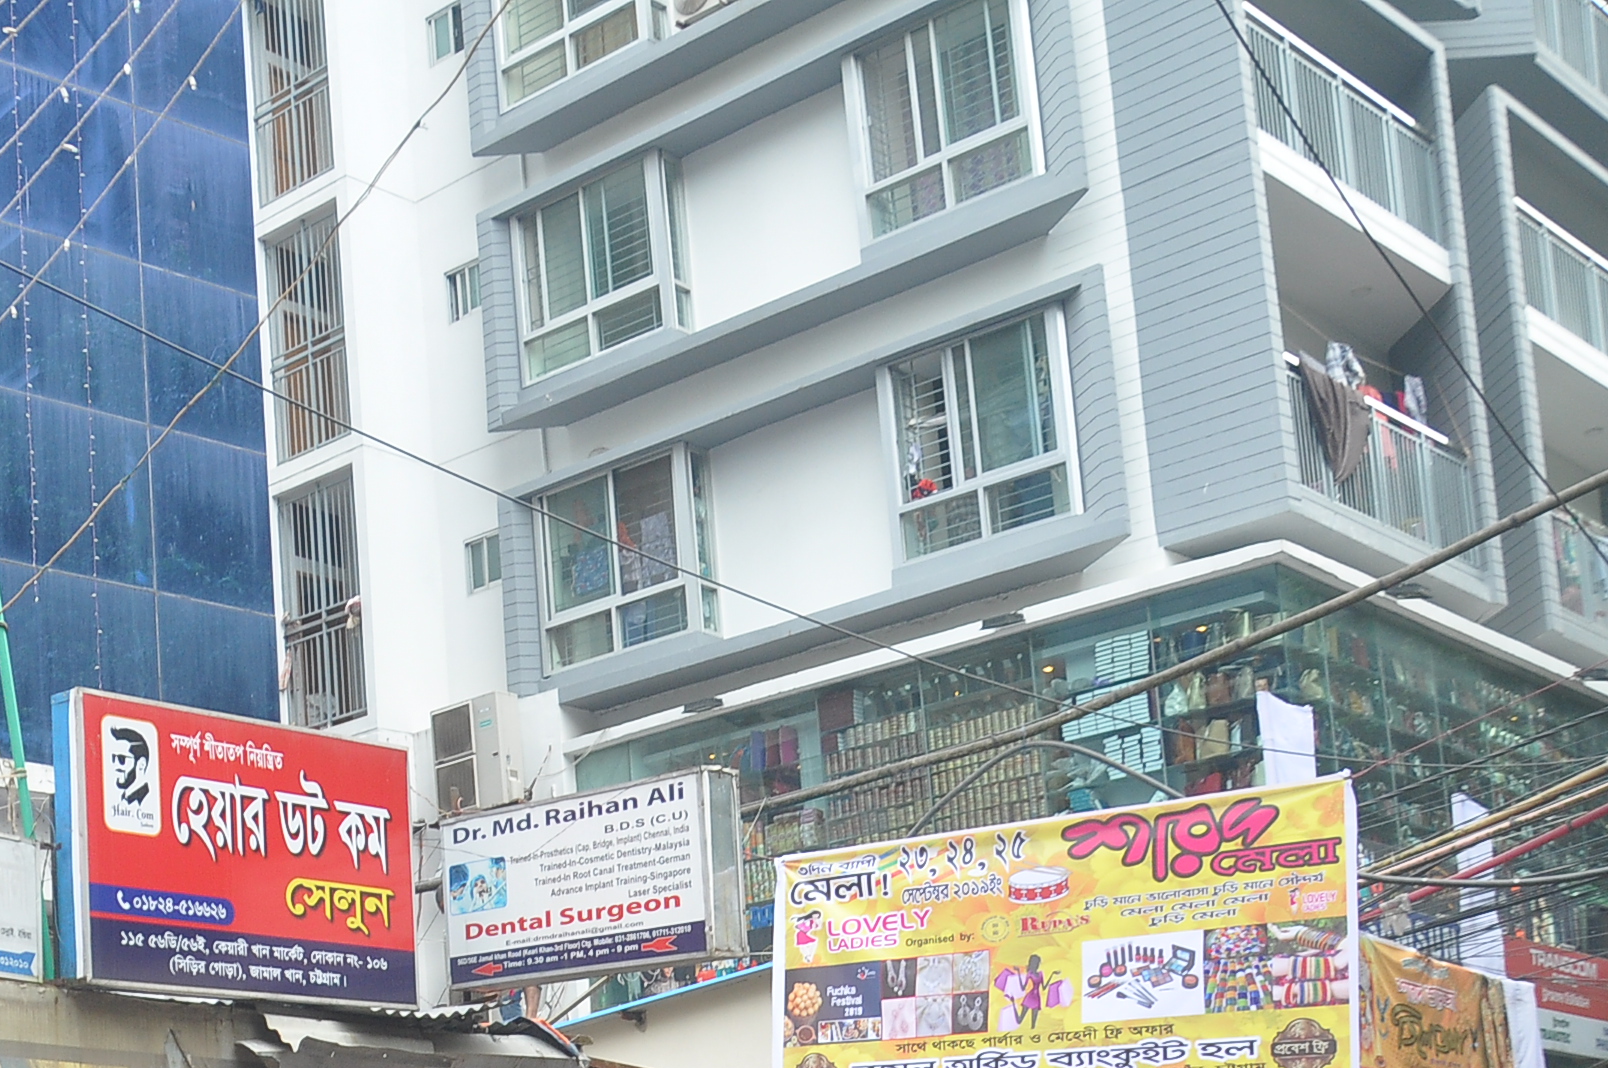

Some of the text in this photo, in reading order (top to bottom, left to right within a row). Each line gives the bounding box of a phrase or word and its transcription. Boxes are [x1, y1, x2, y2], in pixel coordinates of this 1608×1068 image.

[169, 730, 284, 771] সম্পূর্ণ শীতাতপ নিয়ন্ত্রিত
[171, 769, 391, 875] হেয়ার ডট কম
[452, 782, 686, 846] Dr. Md. Raihan Ali
[616, 838, 690, 859] Dentistry-Malaysia
[995, 830, 1029, 862] ২৫
[1209, 837, 1343, 877] মেলা
[592, 852, 691, 878] Canal Treatment-German
[550, 866, 691, 898] Advance Implant Training-Singapore
[628, 879, 692, 899] Laser Specialist
[901, 882, 950, 906] সেপ্টেম্বর
[1145, 885, 1209, 903] ভালোবাসা
[132, 895, 227, 921] ০১৮২৪-৫১৬৬২৬
[285, 877, 395, 937] সেলুন
[464, 893, 682, 941] Dental Surgeon
[1120, 893, 1269, 918] মেলা মেলা মেলা
[1192, 907, 1237, 922] মেলা
[826, 908, 933, 937] LOVELY
[120, 930, 344, 967] ১১৫ কেয়ারী দোকান
[827, 933, 898, 954] LADIES
[905, 934, 955, 948] Organised
[826, 984, 856, 996] Fuchka
[831, 994, 862, 1008] Festival
[845, 1007, 863, 1018] 2019
[932, 1022, 1175, 1052] থাকছে অফার
[1047, 1040, 1189, 1068] ব্যাংকুইট
[1199, 1038, 1258, 1060] হল
